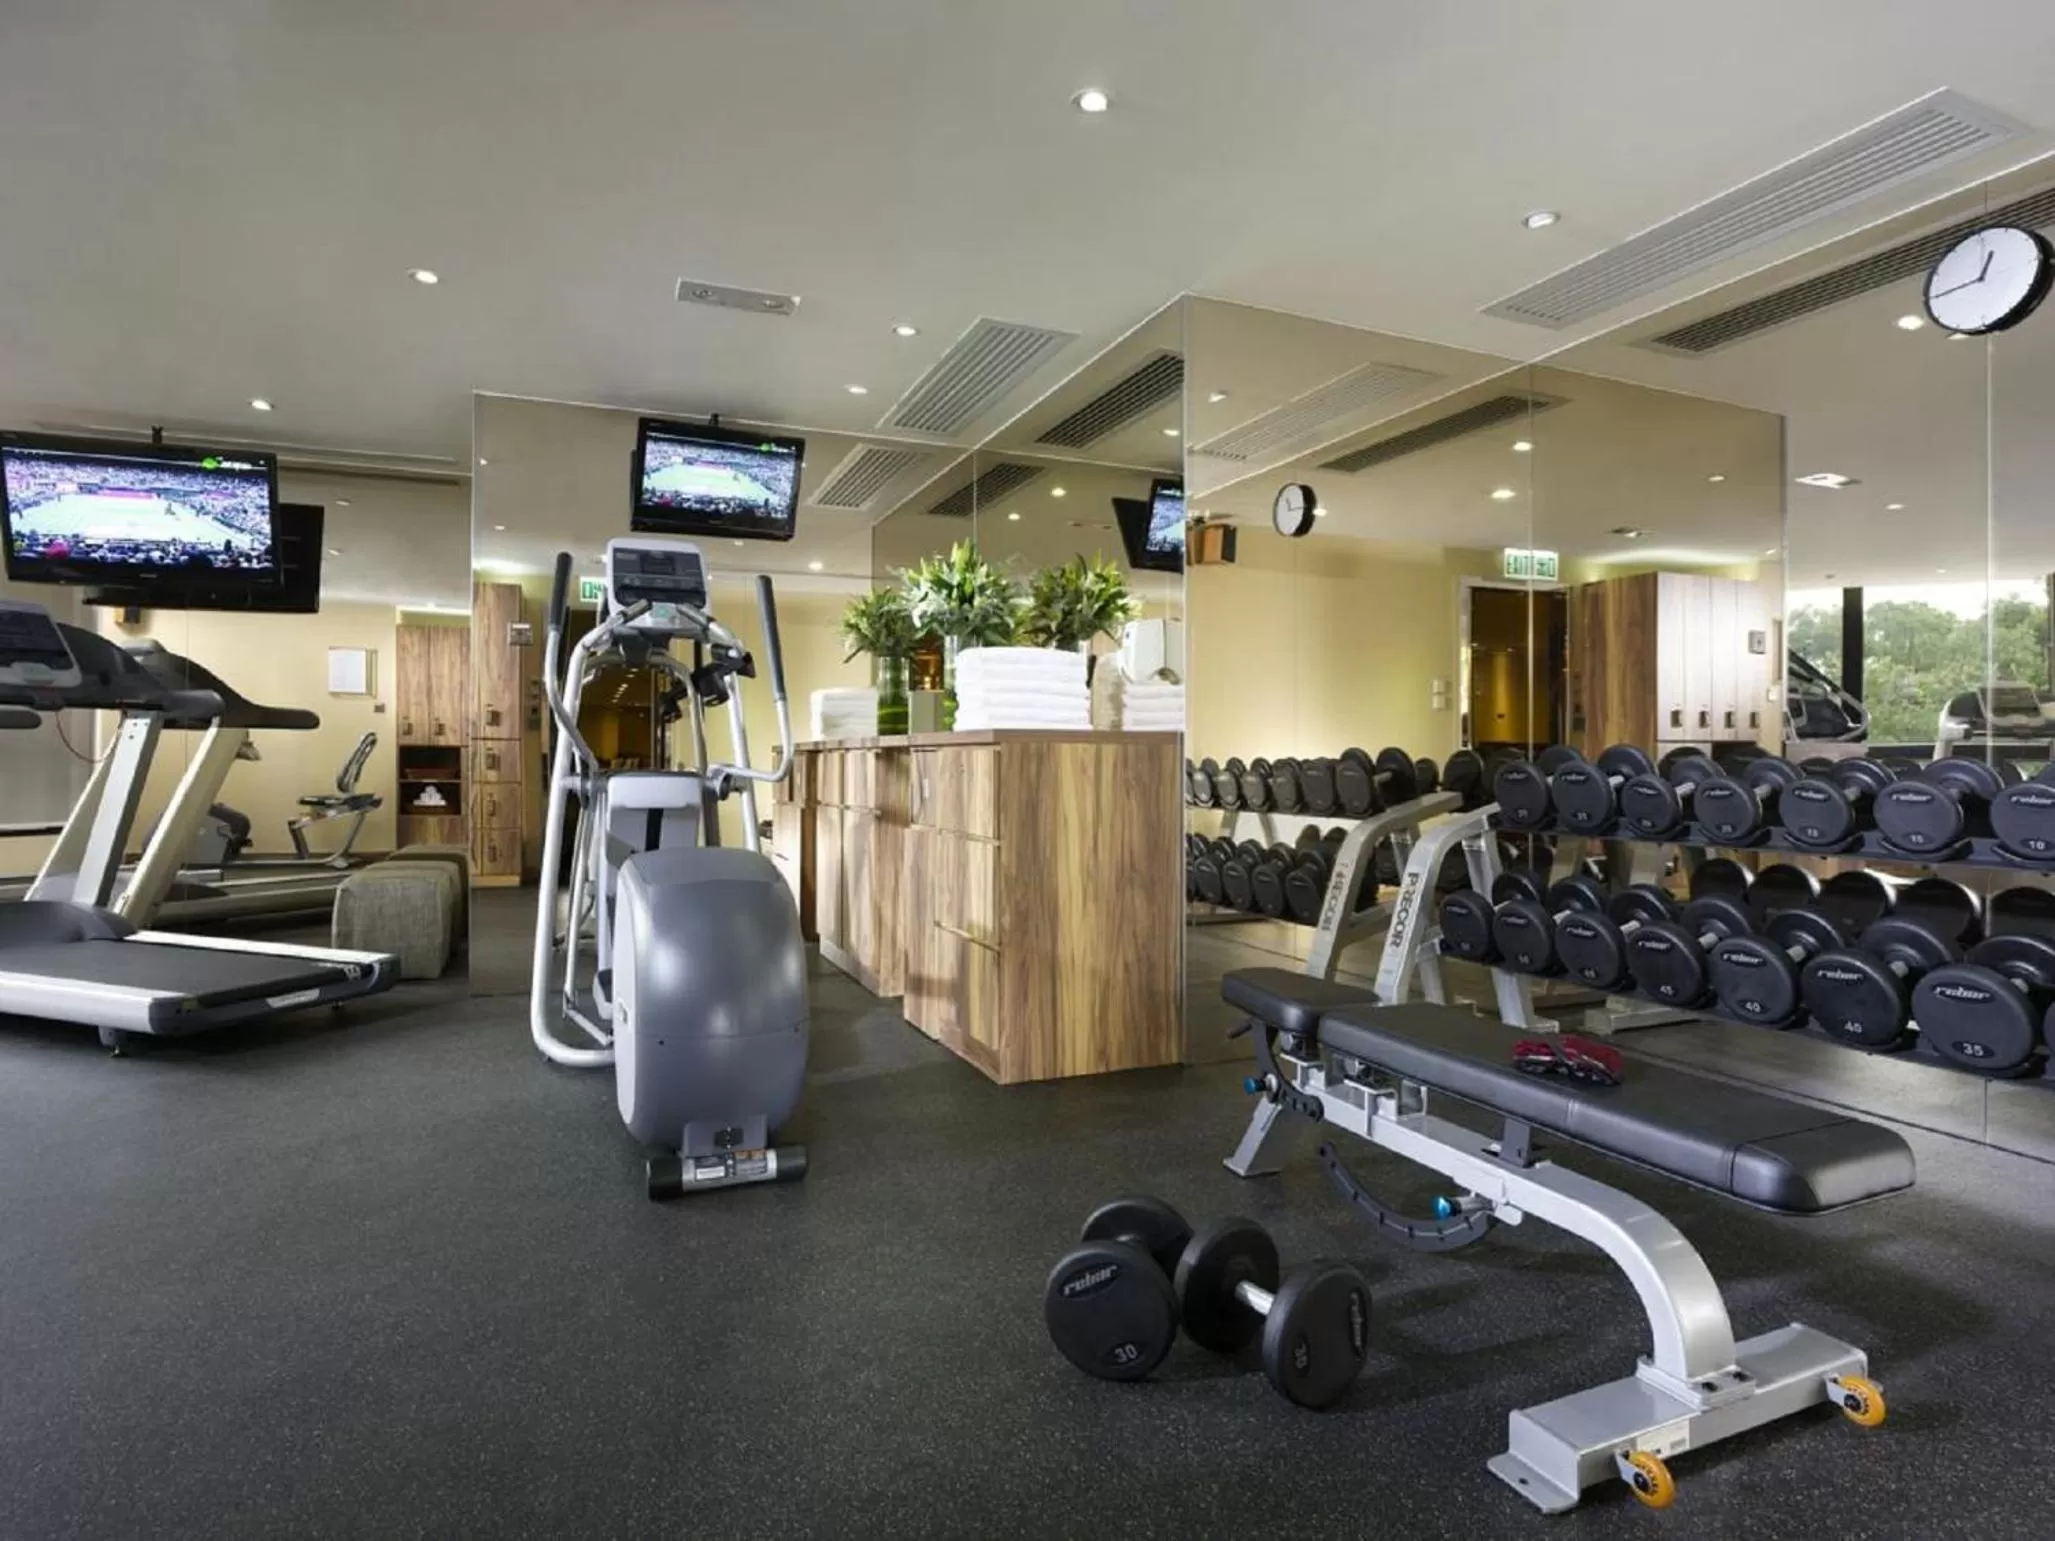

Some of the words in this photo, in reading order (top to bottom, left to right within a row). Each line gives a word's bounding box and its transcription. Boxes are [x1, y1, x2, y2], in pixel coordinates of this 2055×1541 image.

[2027, 840, 2046, 851] 10
[1389, 871, 1420, 948] PRECOR
[1744, 1000, 1761, 1013] 40
[1962, 1042, 1984, 1058] 35
[1114, 1343, 1138, 1363] 30
